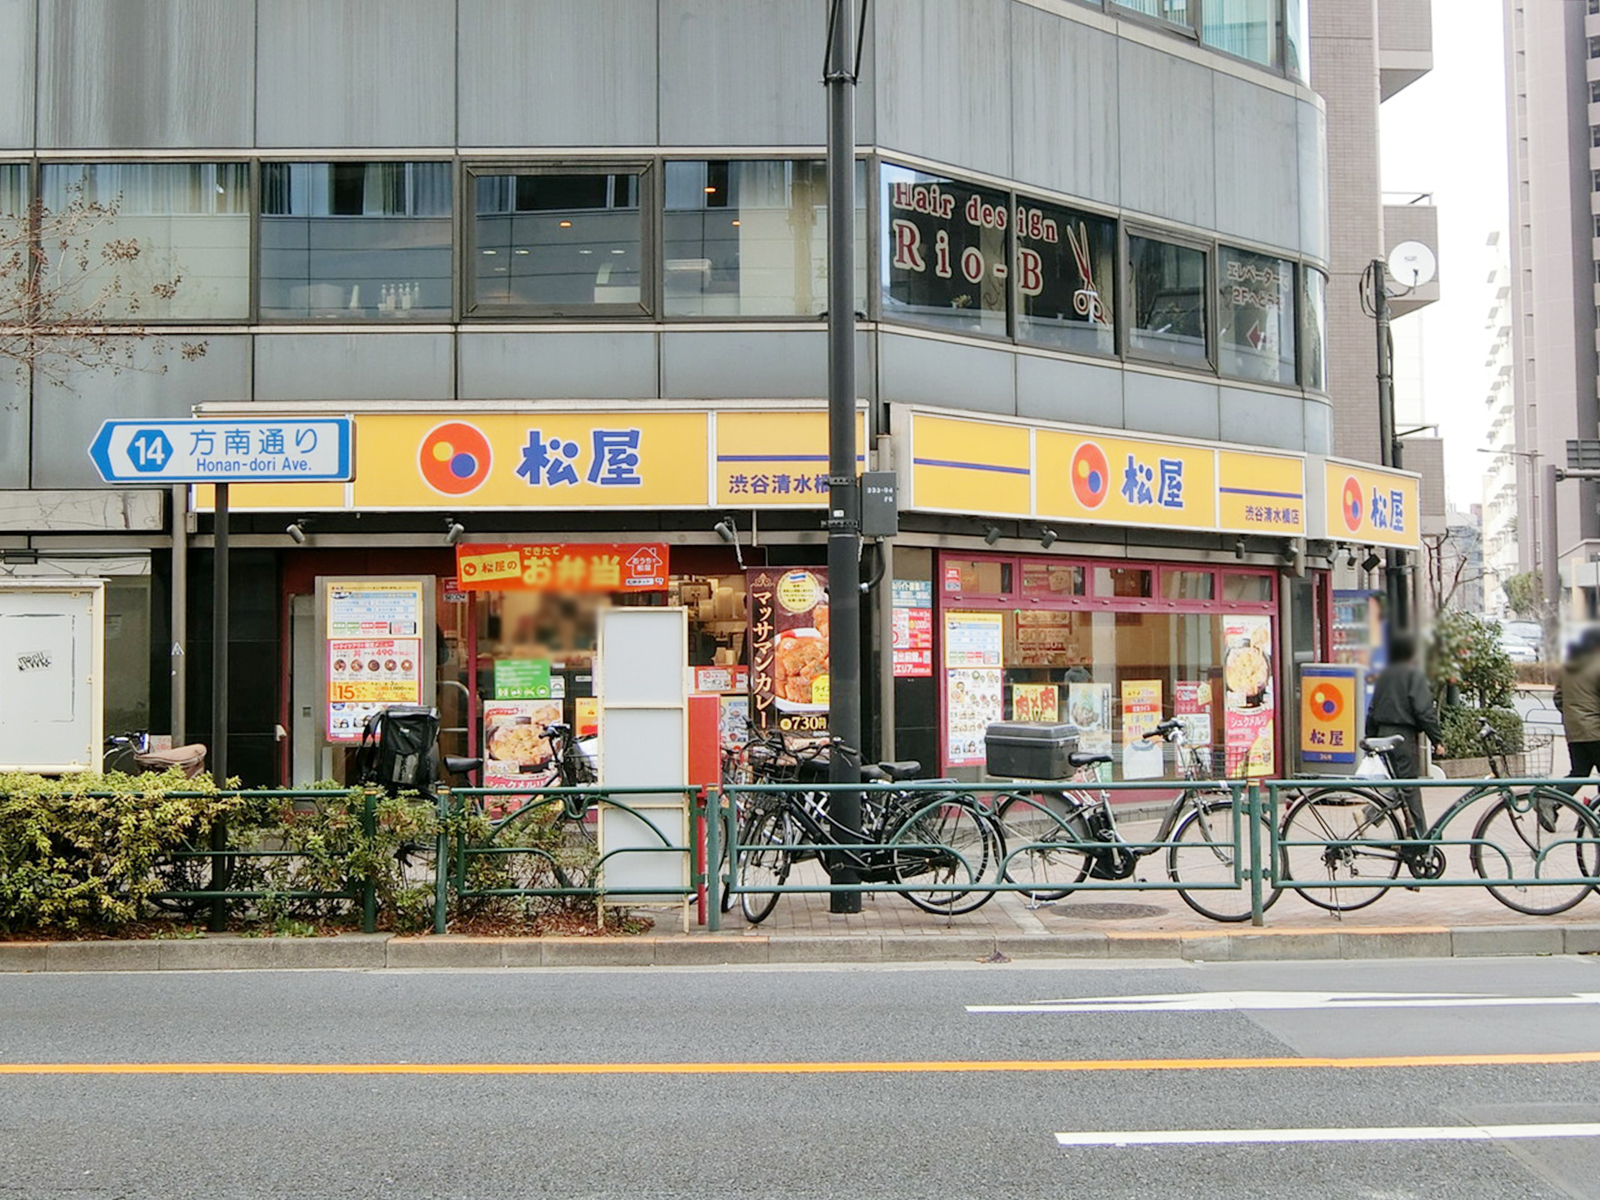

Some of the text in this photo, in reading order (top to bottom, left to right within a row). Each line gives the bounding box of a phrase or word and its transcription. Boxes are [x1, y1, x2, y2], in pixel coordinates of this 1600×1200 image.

[893, 182, 1058, 243] Hair design
[893, 219, 1043, 296] Rio-B
[134, 436, 165, 465] 14
[189, 428, 318, 456] 方南通り
[196, 458, 312, 472] Honan-dori Ave.
[517, 430, 641, 486] 松屋
[1122, 454, 1183, 508] 松屋
[1245, 505, 1300, 526] 渋谷清水橋店
[1371, 488, 1404, 532] 松屋
[523, 547, 560, 556] できたて
[482, 560, 518, 574] 松屋の
[752, 591, 775, 729] マッサマンカレー
[1231, 716, 1267, 728] シュクメルリ
[1310, 729, 1344, 746] 松屋
